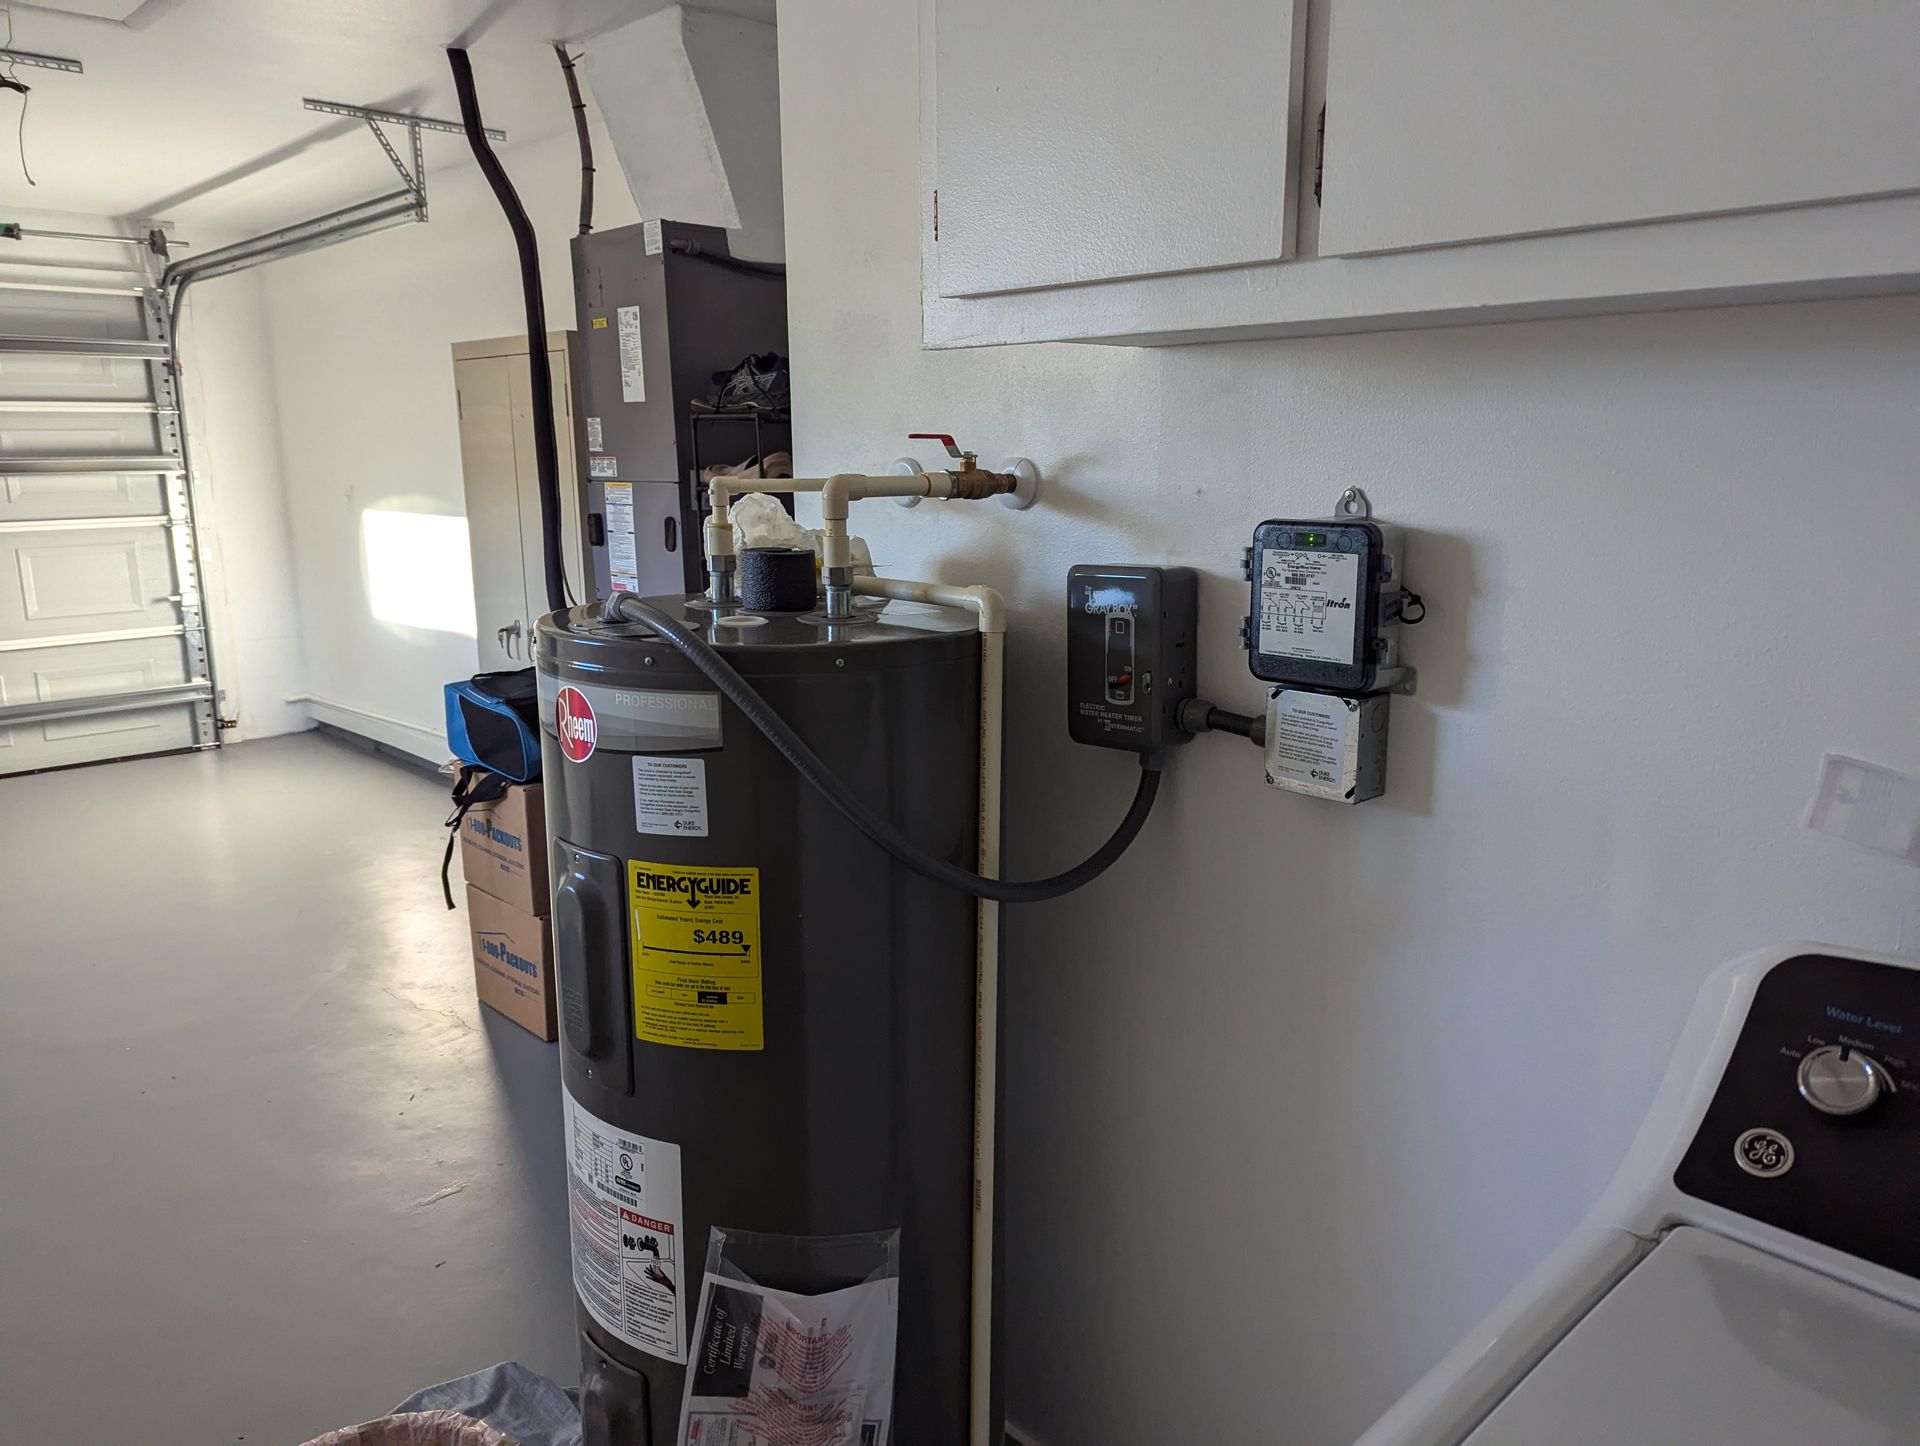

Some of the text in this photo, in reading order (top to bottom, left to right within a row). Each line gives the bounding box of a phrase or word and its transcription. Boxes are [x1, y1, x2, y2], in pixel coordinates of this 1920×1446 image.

[1085, 602, 1109, 614] GRAY
[615, 693, 718, 711] PROFESSIONAL
[1080, 702, 1106, 711] ELECTRIC
[558, 688, 594, 748] Rheem
[1079, 709, 1143, 722] WATER HEATER TIMER
[636, 871, 751, 897] ENERGYGUIDE
[656, 914, 678, 922] Estimated
[679, 916, 693, 924] Yearly
[693, 929, 744, 945] $489
[1825, 1005, 1903, 1034] Water Level
[1807, 1035, 1875, 1050] Low Medium
[1779, 1046, 1801, 1058] Auto
[631, 1214, 671, 1233] DANGER
[703, 1304, 728, 1375] Certificate of
[785, 1321, 827, 1345] IMPORTANT
[719, 1322, 737, 1365] Limited
